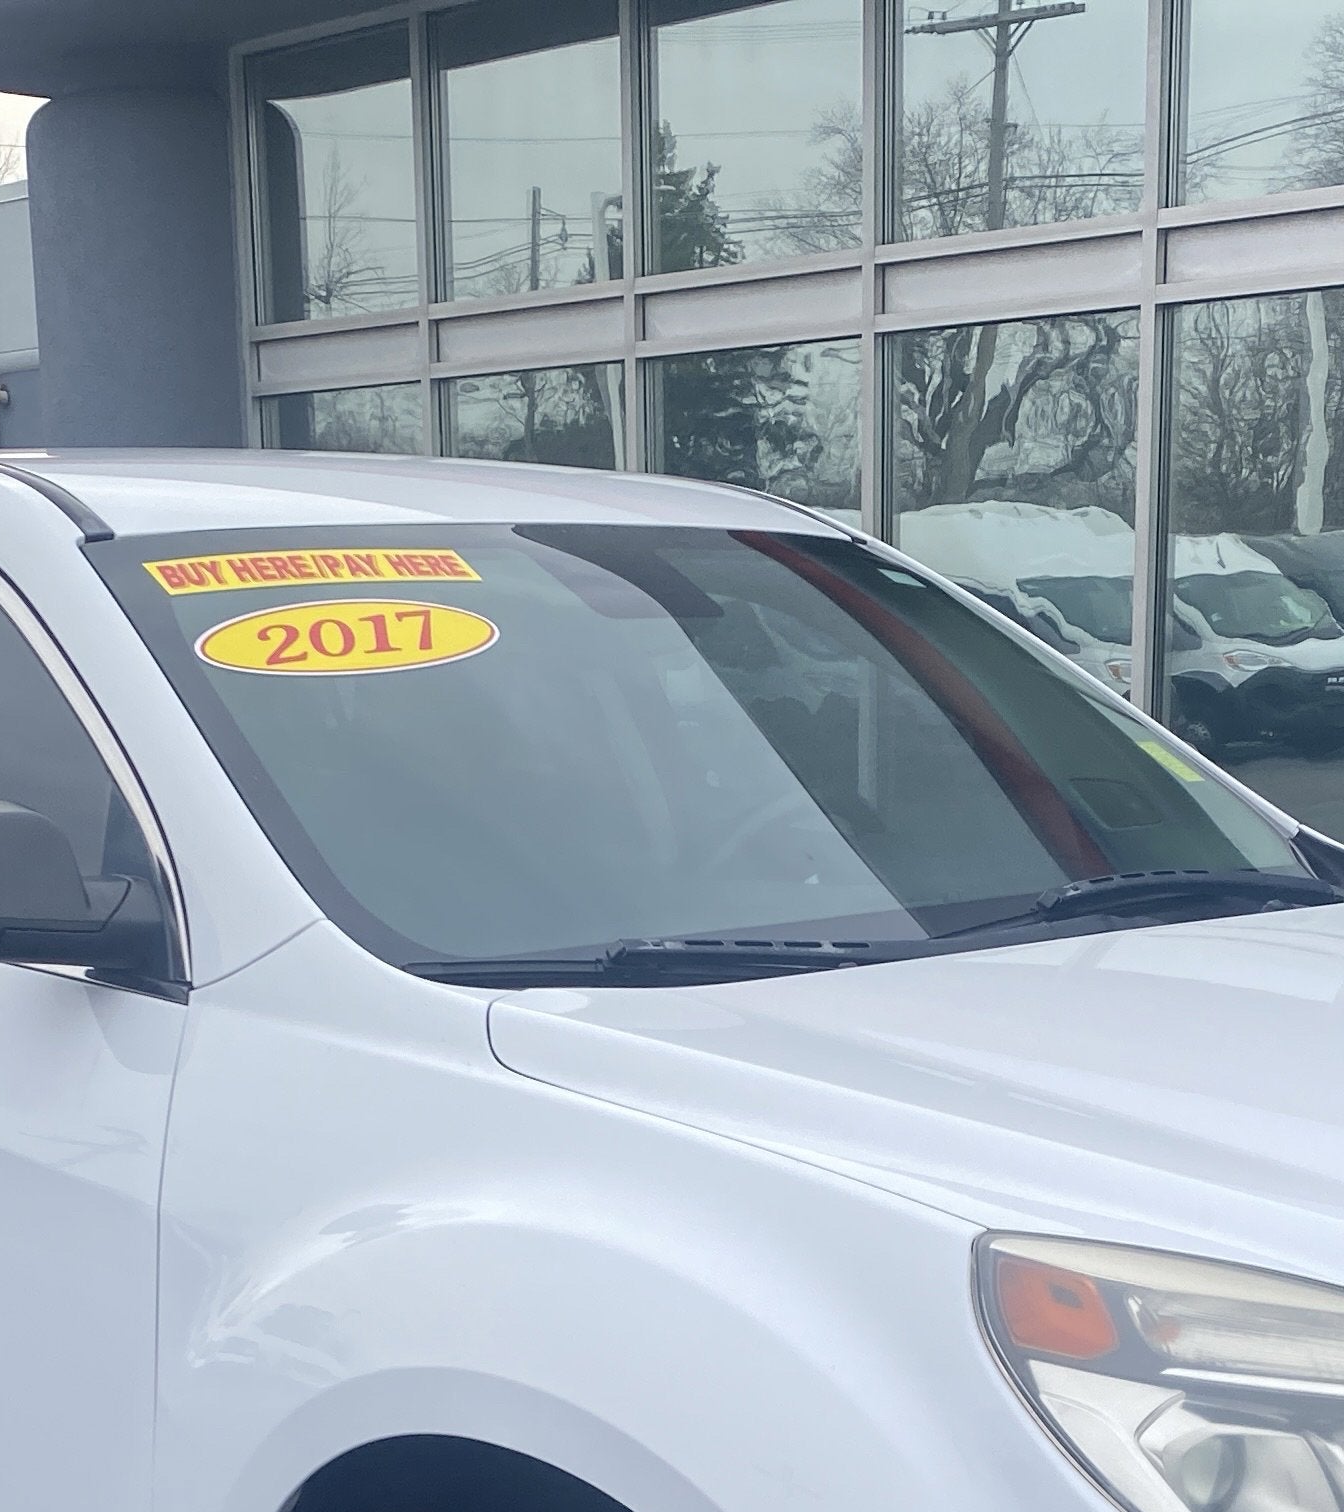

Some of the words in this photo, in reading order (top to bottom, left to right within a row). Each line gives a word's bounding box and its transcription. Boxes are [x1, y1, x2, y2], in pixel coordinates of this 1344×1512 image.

[156, 561, 228, 590] BUY
[384, 552, 471, 579] HERE
[257, 609, 434, 666] 2017
